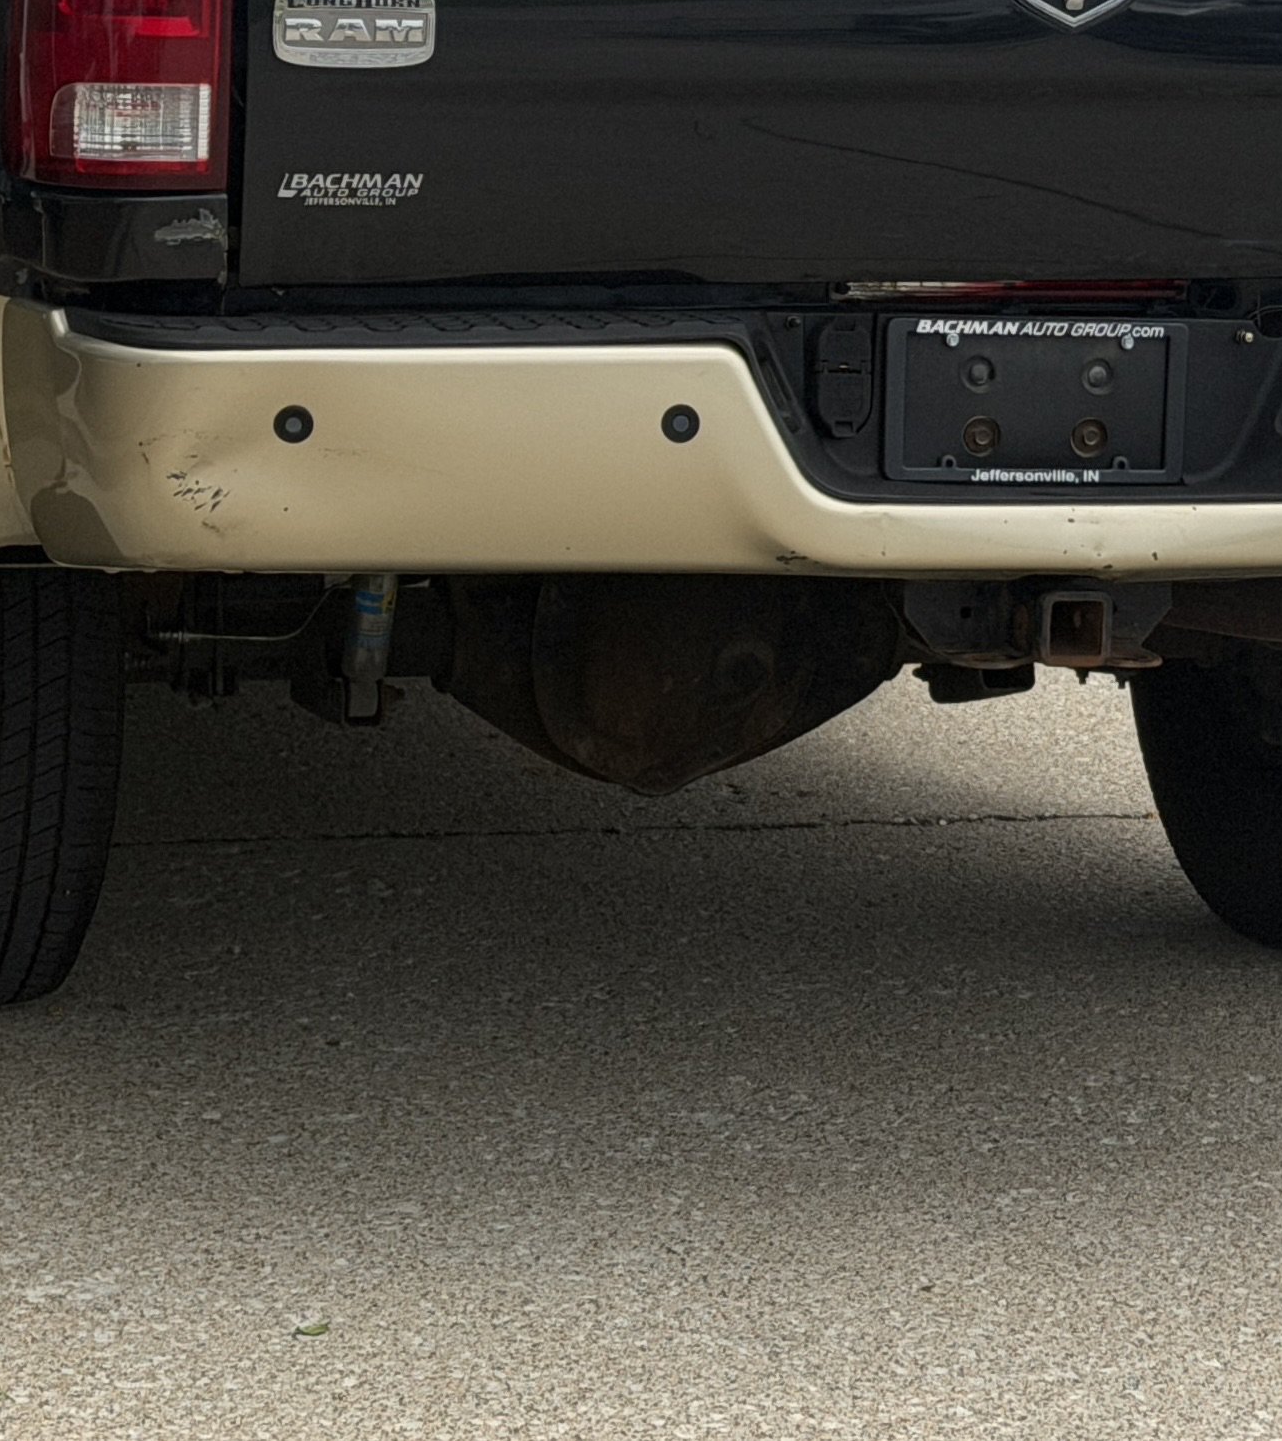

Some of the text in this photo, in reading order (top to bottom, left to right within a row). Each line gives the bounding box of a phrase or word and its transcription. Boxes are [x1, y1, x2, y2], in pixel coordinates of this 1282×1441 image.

[284, 18, 423, 42] RAM
[289, 173, 424, 189] BACHMAN
[300, 188, 419, 197] AUTO GROUP
[385, 197, 396, 206] IN
[916, 319, 1020, 336] BACHMAN
[1020, 321, 1068, 337] AUTO
[971, 469, 1099, 483] Jeffersonville, IN
